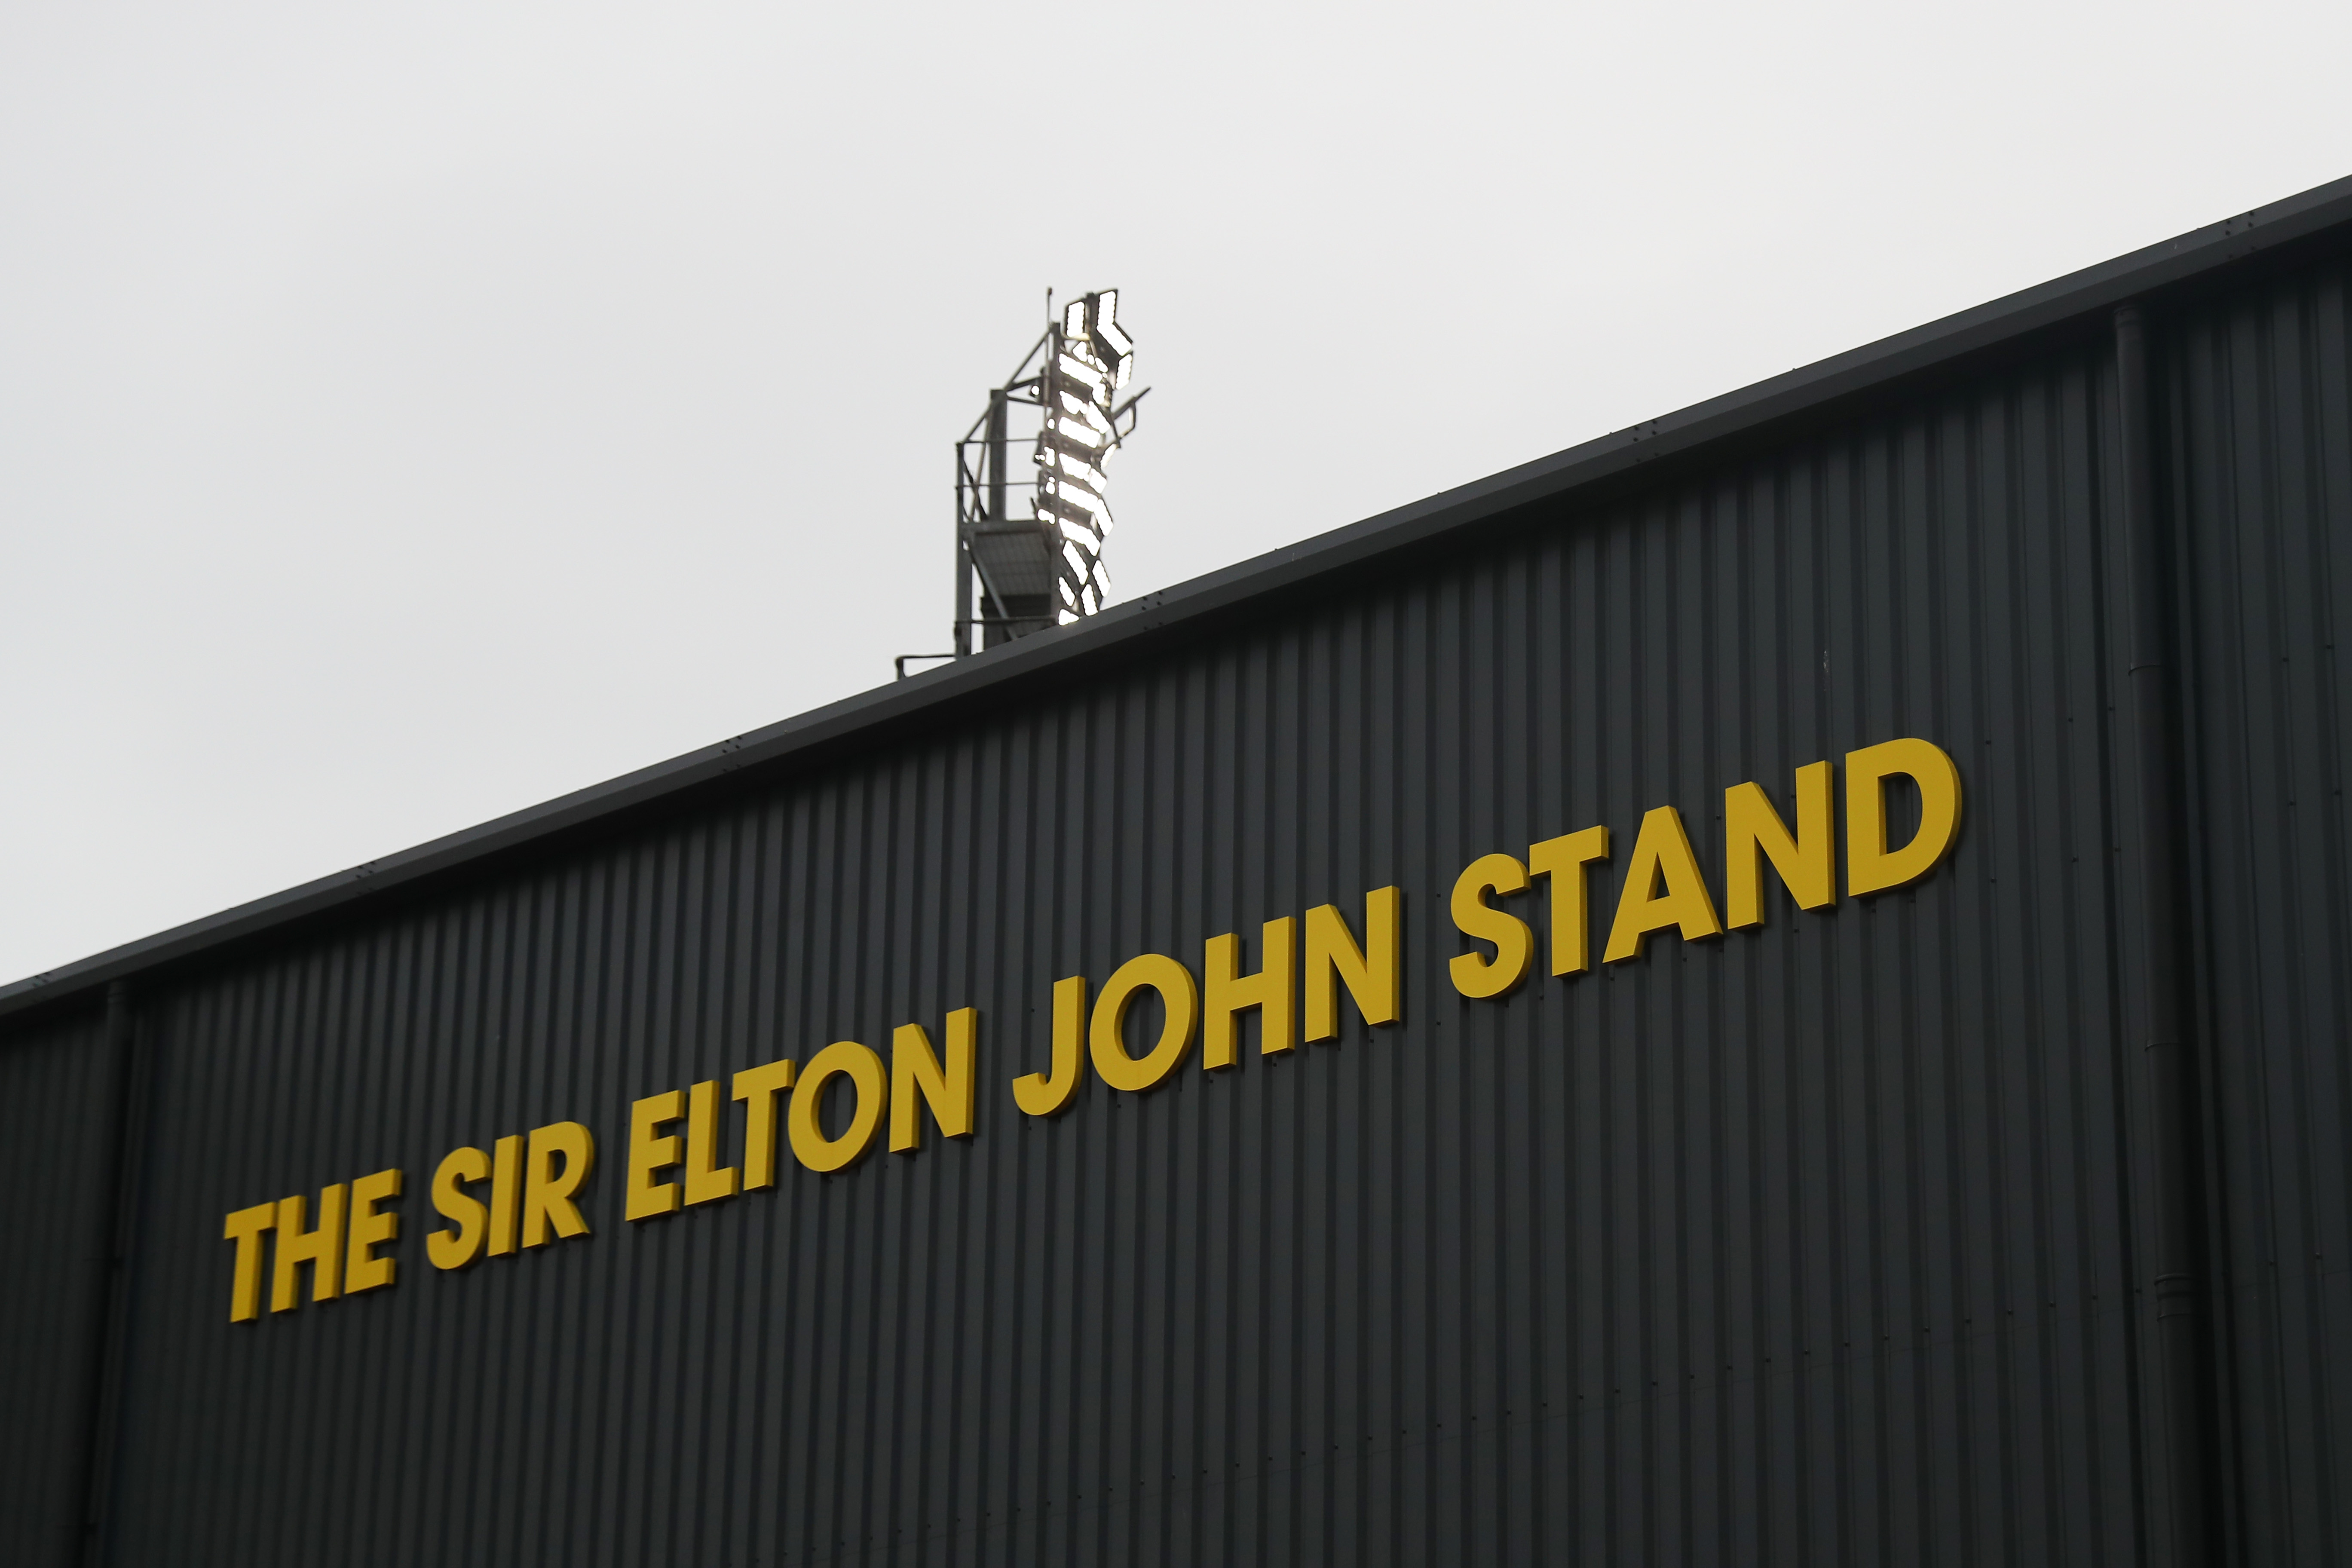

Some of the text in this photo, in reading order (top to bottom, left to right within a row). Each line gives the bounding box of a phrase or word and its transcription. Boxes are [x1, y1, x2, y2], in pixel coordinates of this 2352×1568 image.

[224, 737, 1963, 1323] THE SIR ELTON JOHN STAND
